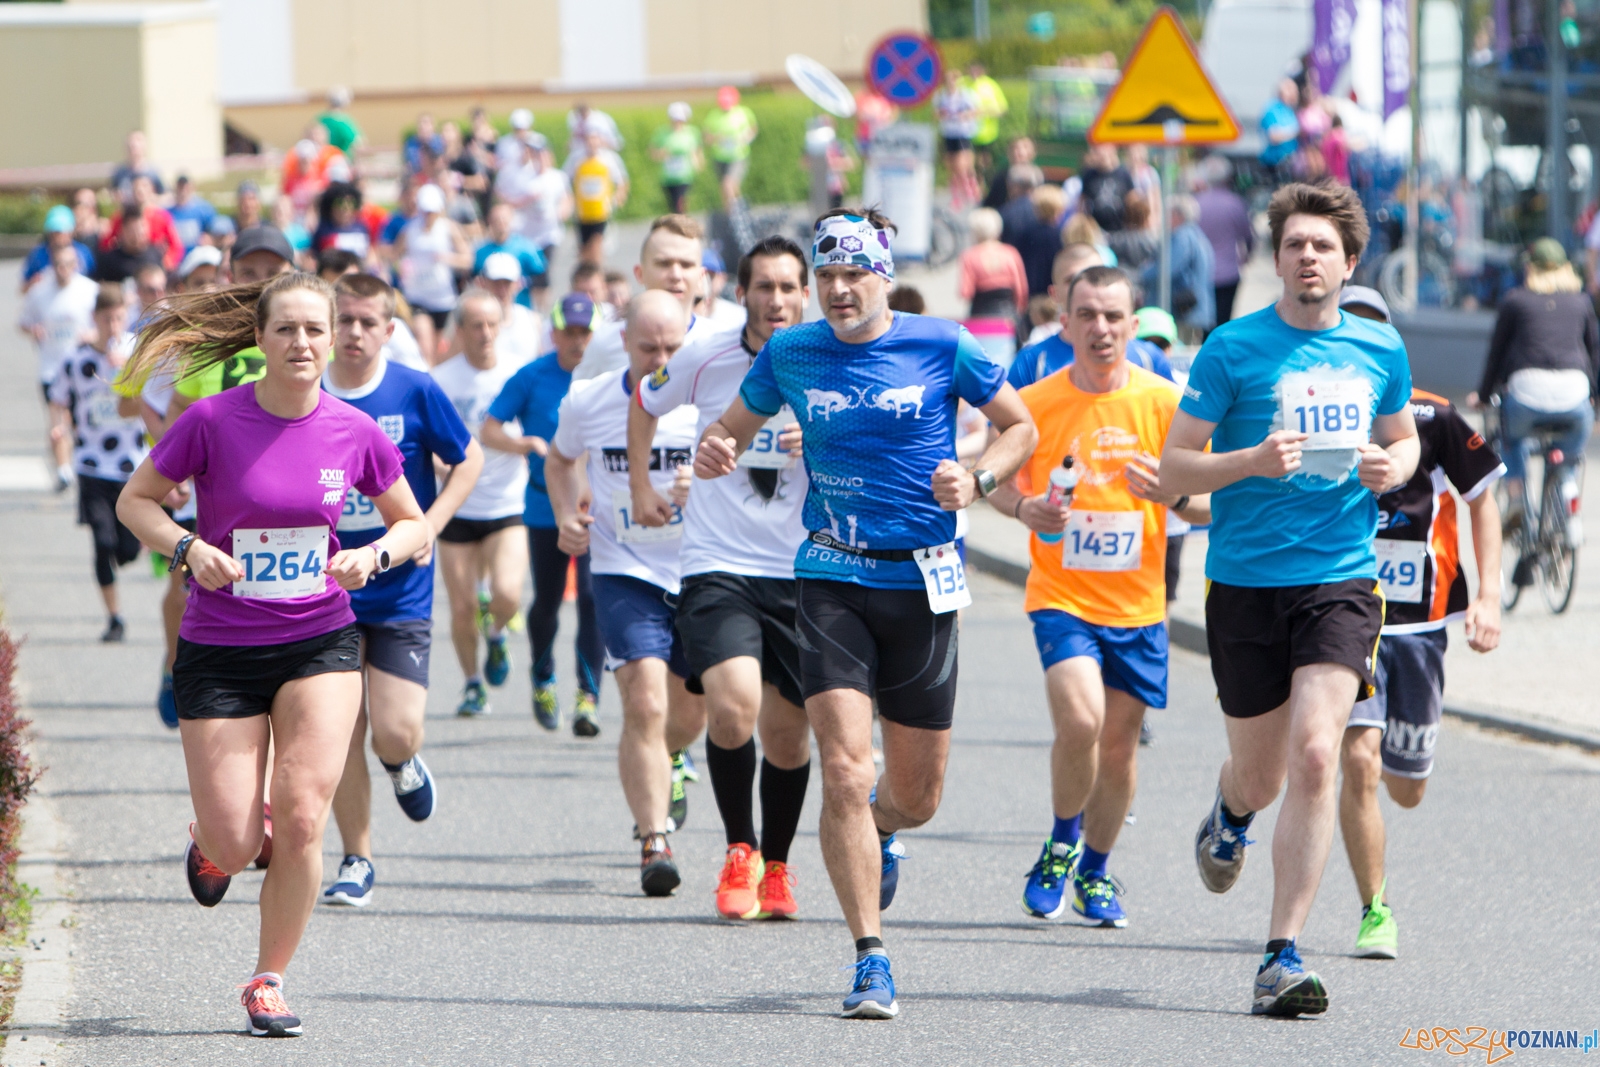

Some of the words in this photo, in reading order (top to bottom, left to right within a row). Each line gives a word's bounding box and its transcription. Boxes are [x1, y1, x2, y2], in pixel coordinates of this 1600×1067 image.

[1295, 403, 1360, 433] 1189
[1071, 530, 1136, 556] 1437
[240, 550, 321, 582] 1264
[1378, 560, 1416, 586] 49
[1386, 716, 1439, 751] NYC
